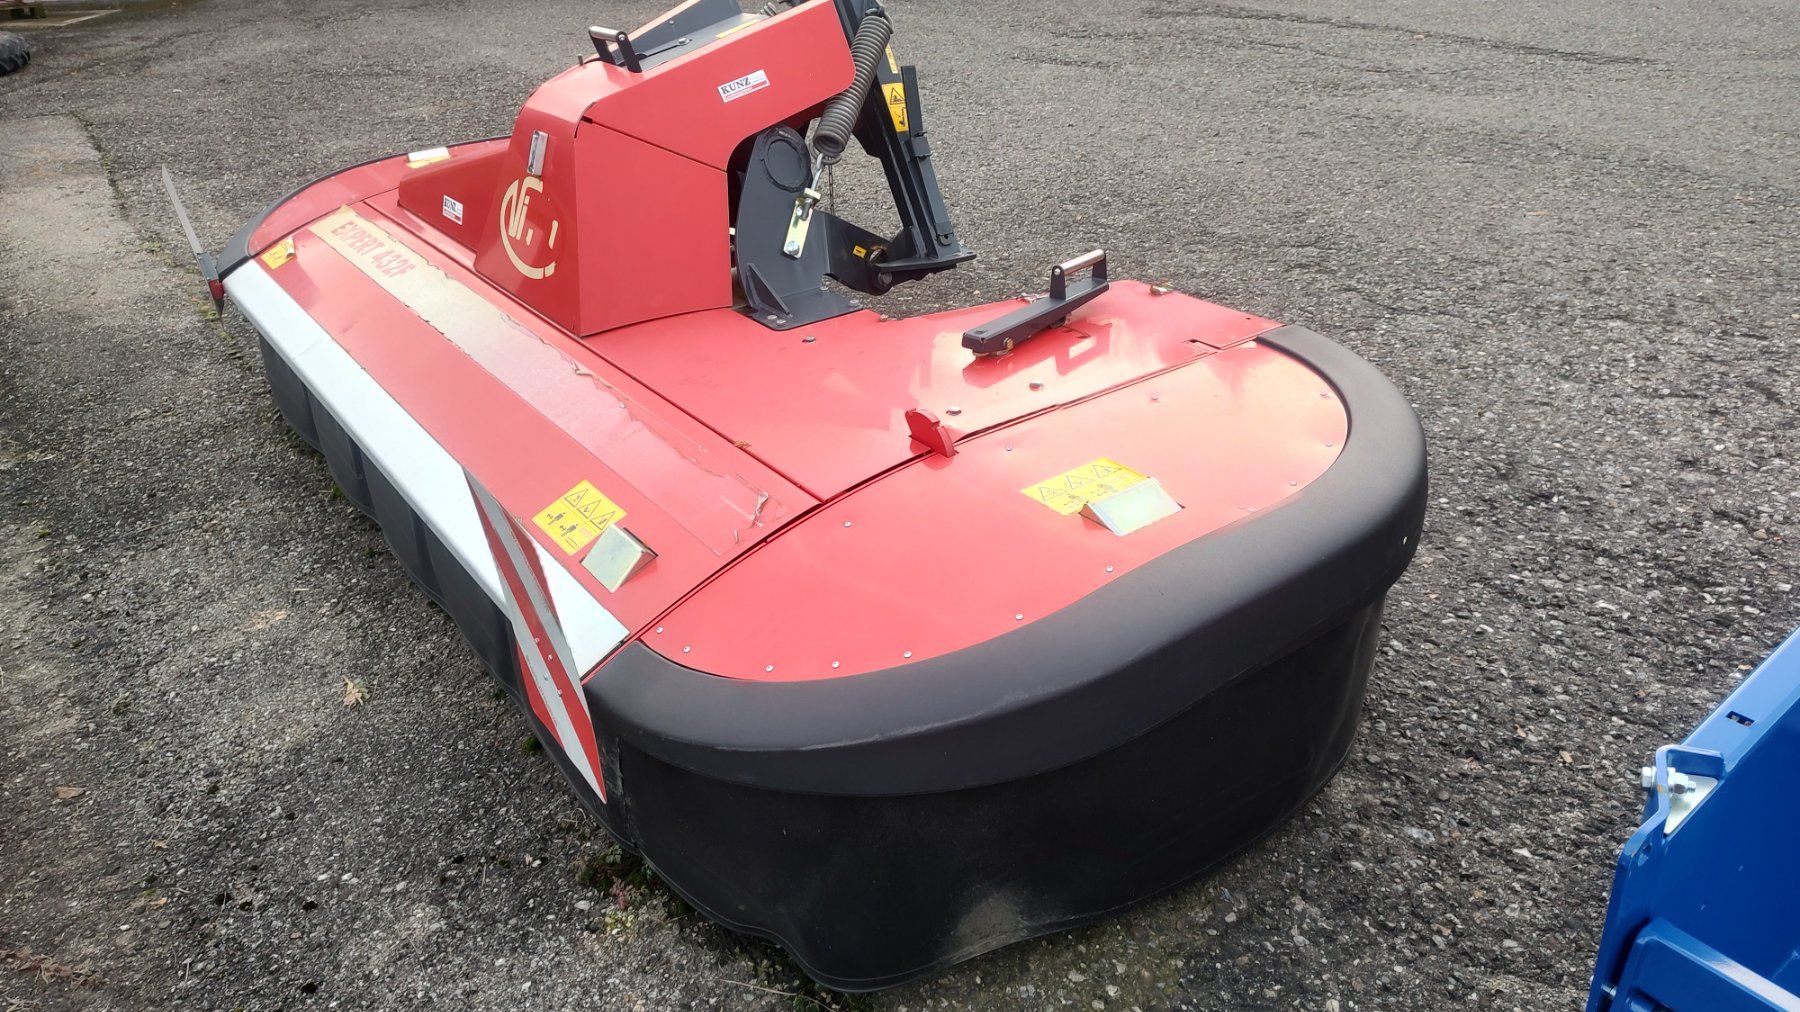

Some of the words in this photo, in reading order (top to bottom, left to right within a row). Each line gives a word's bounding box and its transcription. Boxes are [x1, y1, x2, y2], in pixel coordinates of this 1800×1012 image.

[720, 76, 751, 95] KUNZ
[331, 220, 386, 256] EXPERT
[371, 249, 416, 278] 432F
